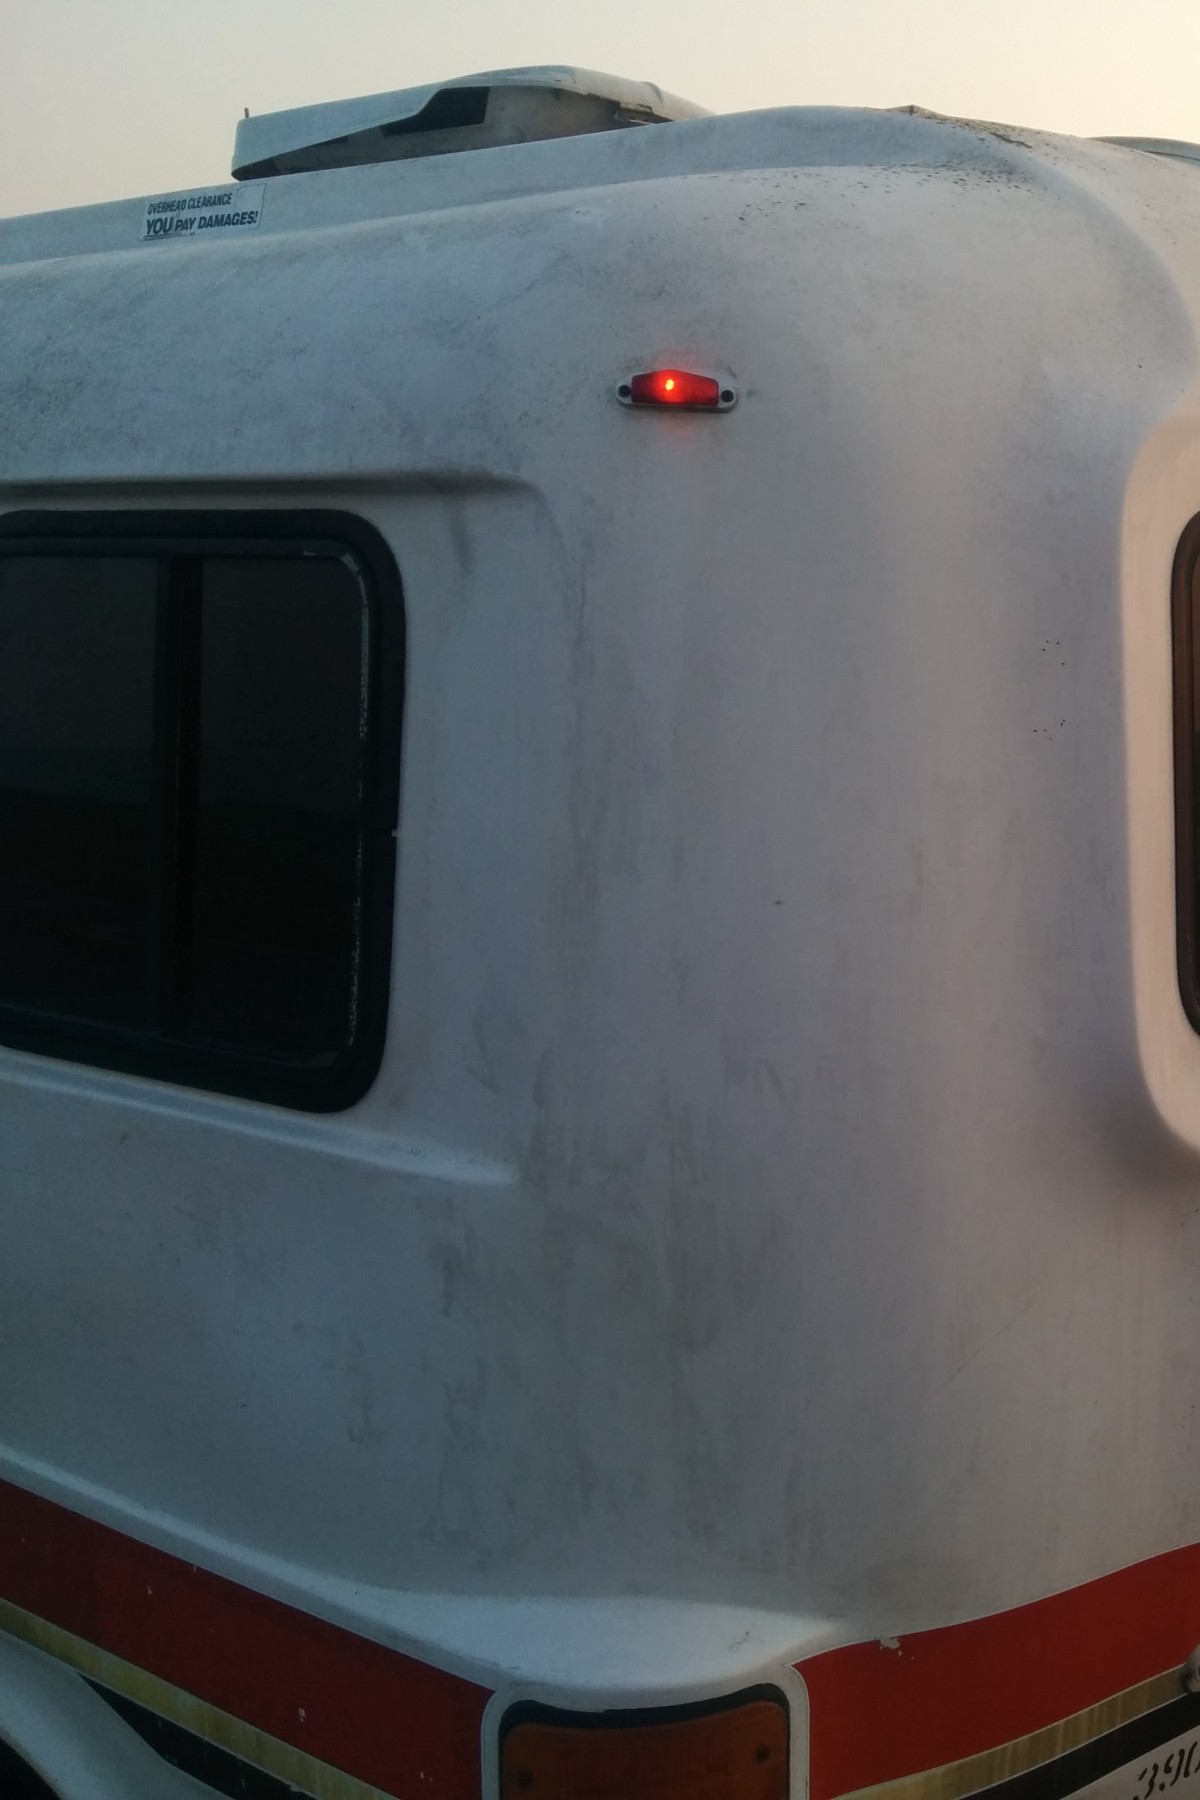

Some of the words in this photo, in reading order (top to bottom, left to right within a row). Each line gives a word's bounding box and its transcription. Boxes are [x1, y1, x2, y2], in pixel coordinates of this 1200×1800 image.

[147, 199, 187, 215] OVERHEAD
[187, 193, 233, 210] CLEARANCE
[146, 216, 174, 235] YOU
[174, 216, 197, 231] PAY
[197, 210, 259, 230] DAMAGES!
